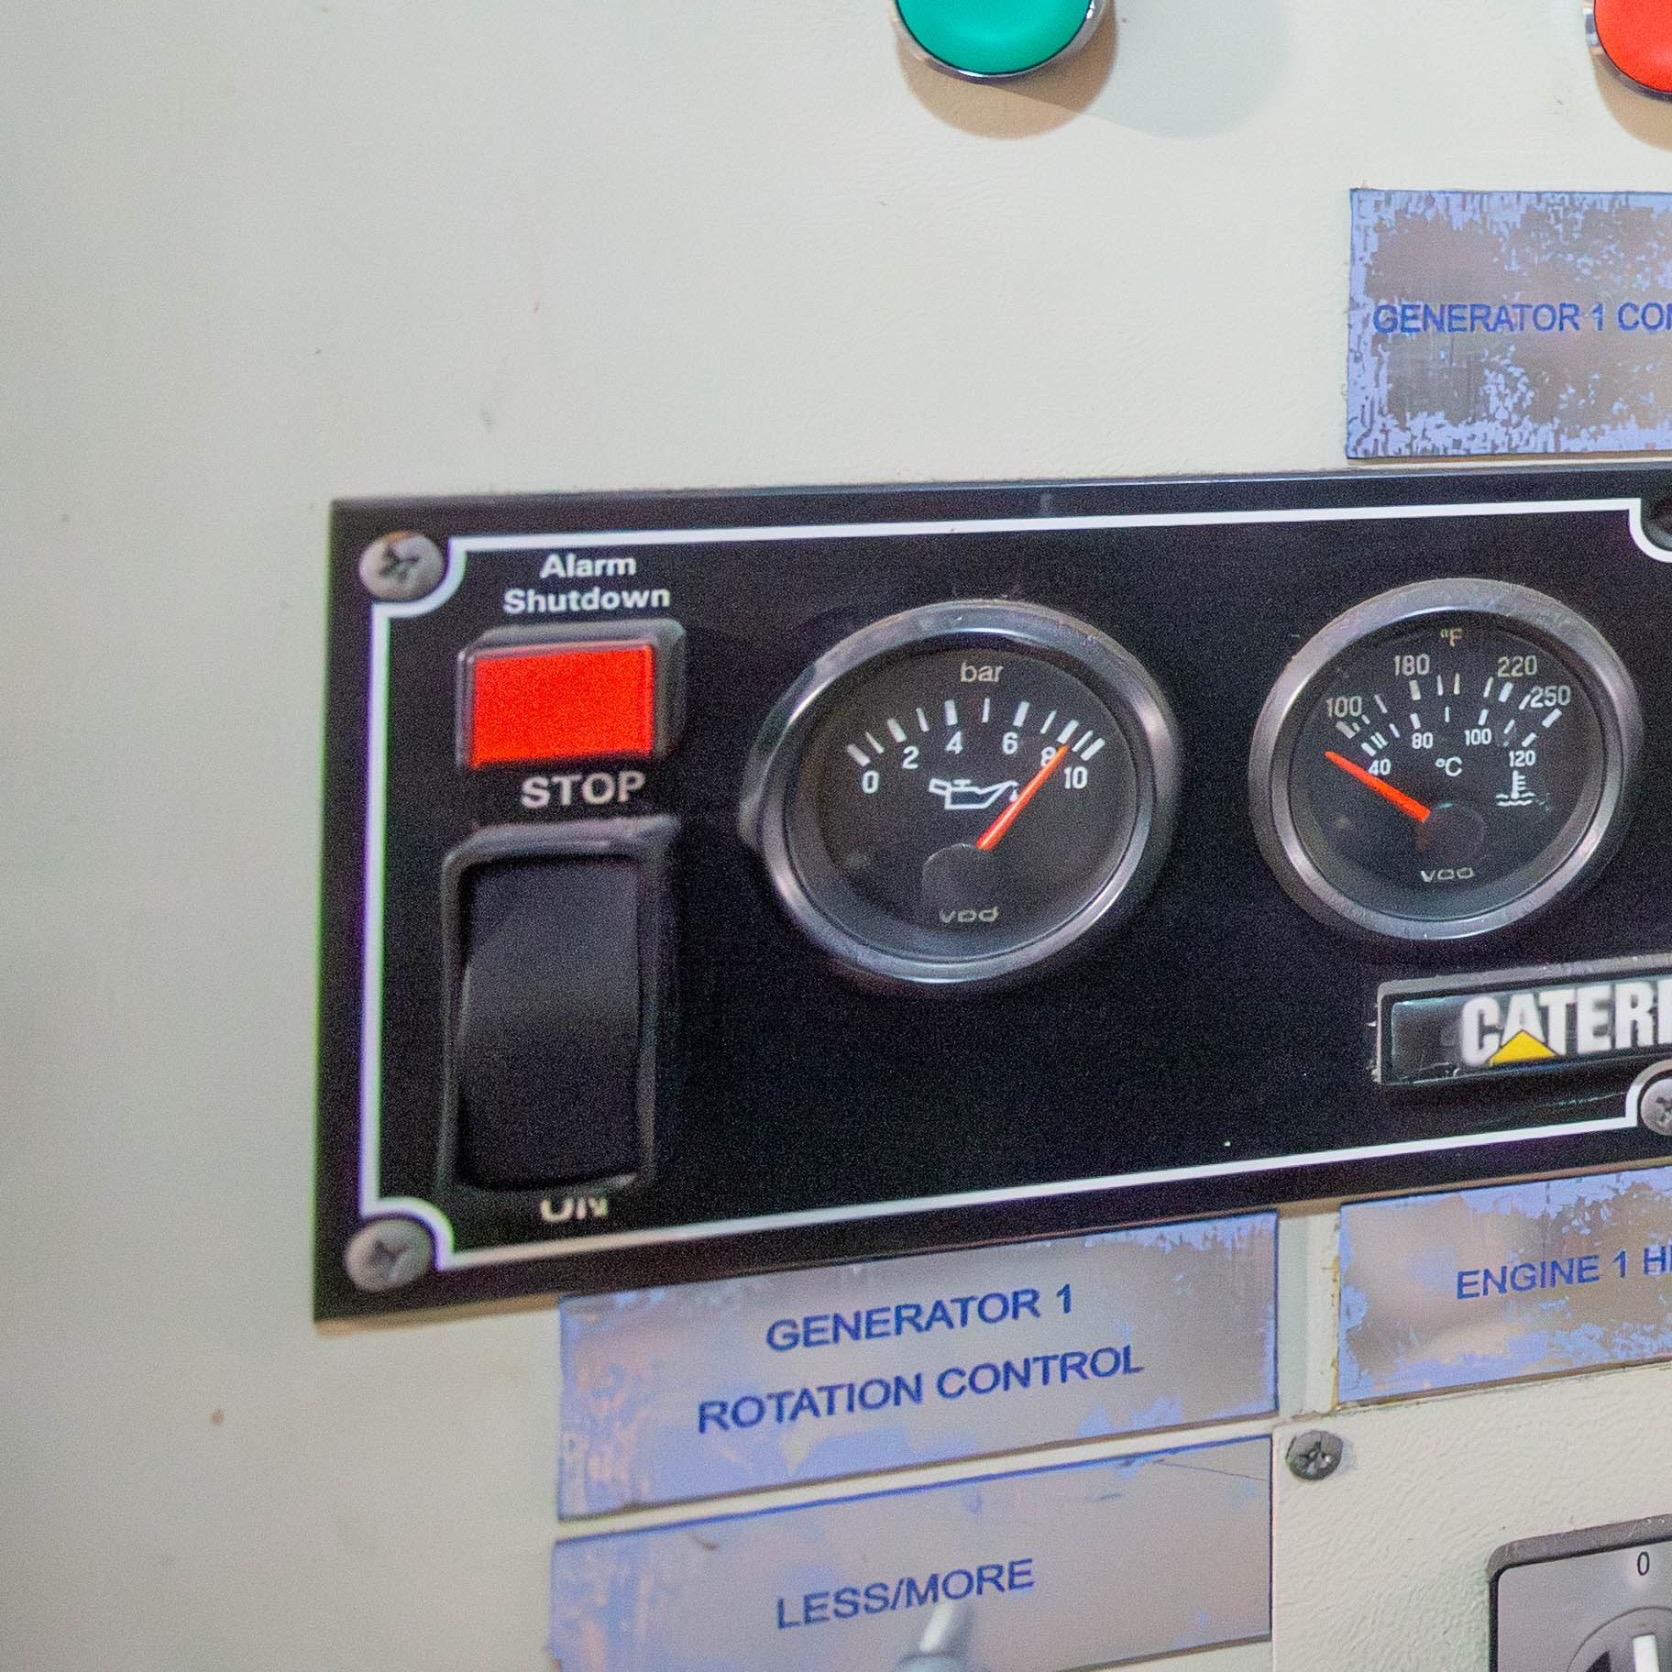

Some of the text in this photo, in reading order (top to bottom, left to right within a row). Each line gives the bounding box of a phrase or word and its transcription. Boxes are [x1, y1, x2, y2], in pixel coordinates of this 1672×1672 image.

[1373, 303, 1580, 335] GENERATOR
[1591, 303, 1605, 331] 1
[539, 554, 637, 579] Alarm
[503, 586, 671, 615] Shutdown
[960, 662, 1004, 684] bar
[1394, 654, 1430, 676] 180
[1498, 656, 1538, 678] 220
[1327, 696, 1362, 717] 100
[1530, 685, 1571, 707] 250
[946, 732, 963, 755] 4
[1003, 732, 1018, 755] 6
[1412, 732, 1433, 749] 80
[1465, 730, 1492, 746] 100
[902, 747, 919, 769] 2
[1040, 747, 1055, 768] 8
[1368, 760, 1391, 776] 40
[1434, 758, 1463, 777] °C
[1509, 751, 1536, 767] 120
[862, 770, 879, 794] 0
[1064, 766, 1087, 789] 10
[520, 770, 645, 809] STOP
[1456, 1256, 1601, 1301] ENGINE
[1613, 1251, 1628, 1279] 1
[765, 1284, 1074, 1353] GENERATOR 1
[697, 1344, 1144, 1435] ROTATION CONTROL
[1637, 1553, 1651, 1577] 0
[776, 1557, 1036, 1631] LESS/MORE
